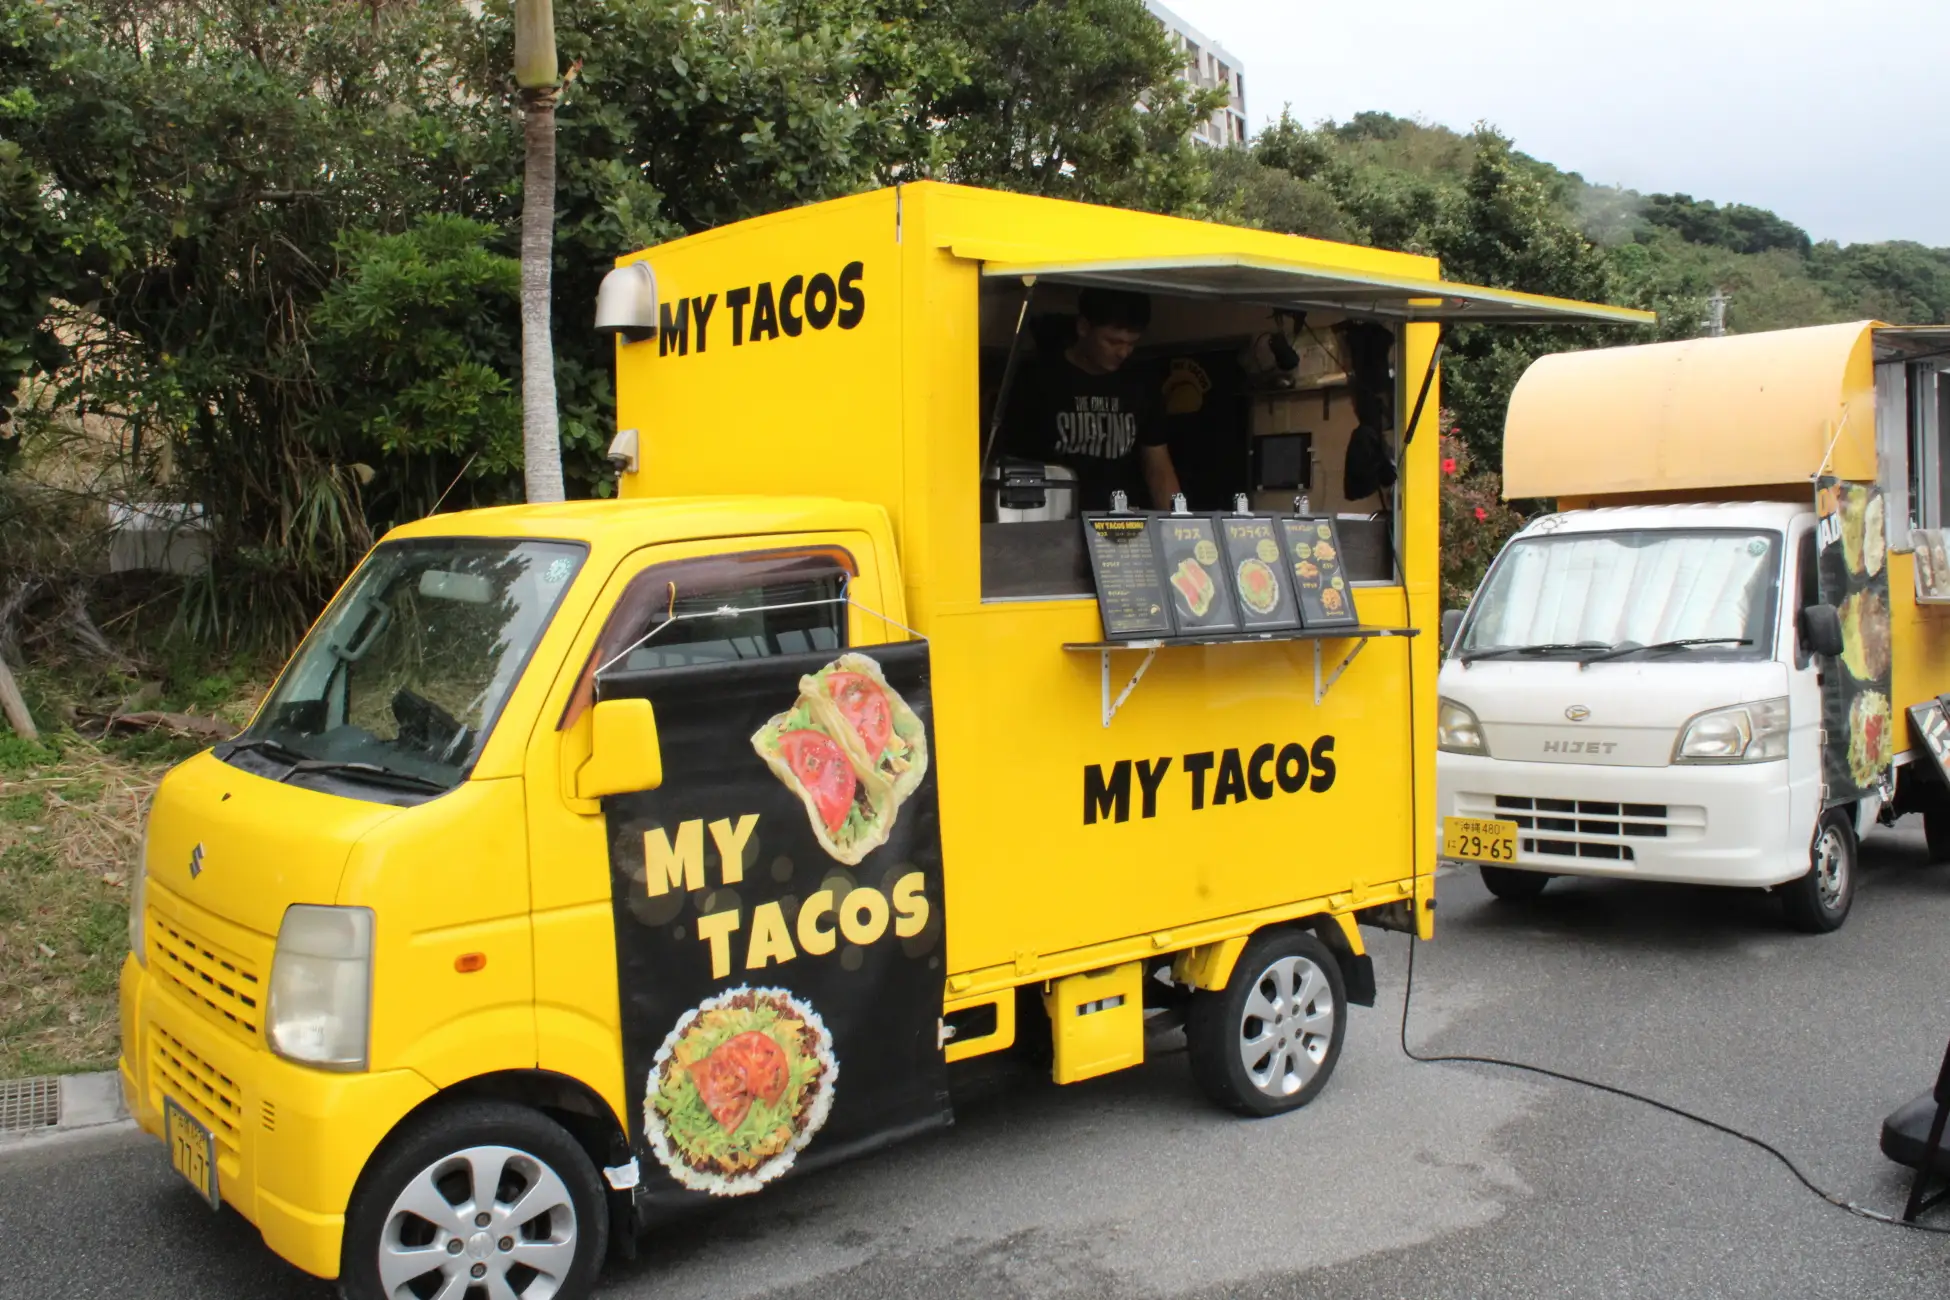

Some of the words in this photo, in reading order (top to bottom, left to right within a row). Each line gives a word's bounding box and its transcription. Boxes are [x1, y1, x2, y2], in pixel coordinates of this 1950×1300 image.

[659, 294, 718, 357] MY
[726, 261, 865, 347] TACOS
[1054, 411, 1136, 459] SURFING
[1094, 522, 1105, 530] MY
[1105, 522, 1126, 530] TACOS
[1174, 527, 1202, 541] タコス
[1229, 525, 1271, 539] タコライス
[1543, 741, 1618, 755] HIJET
[1083, 757, 1173, 825] MY
[1183, 735, 1336, 811] TACOS
[1482, 823, 1501, 835] 480
[644, 814, 760, 897] MY
[1459, 835, 1513, 859] 29-65
[697, 872, 930, 980] TACOS
